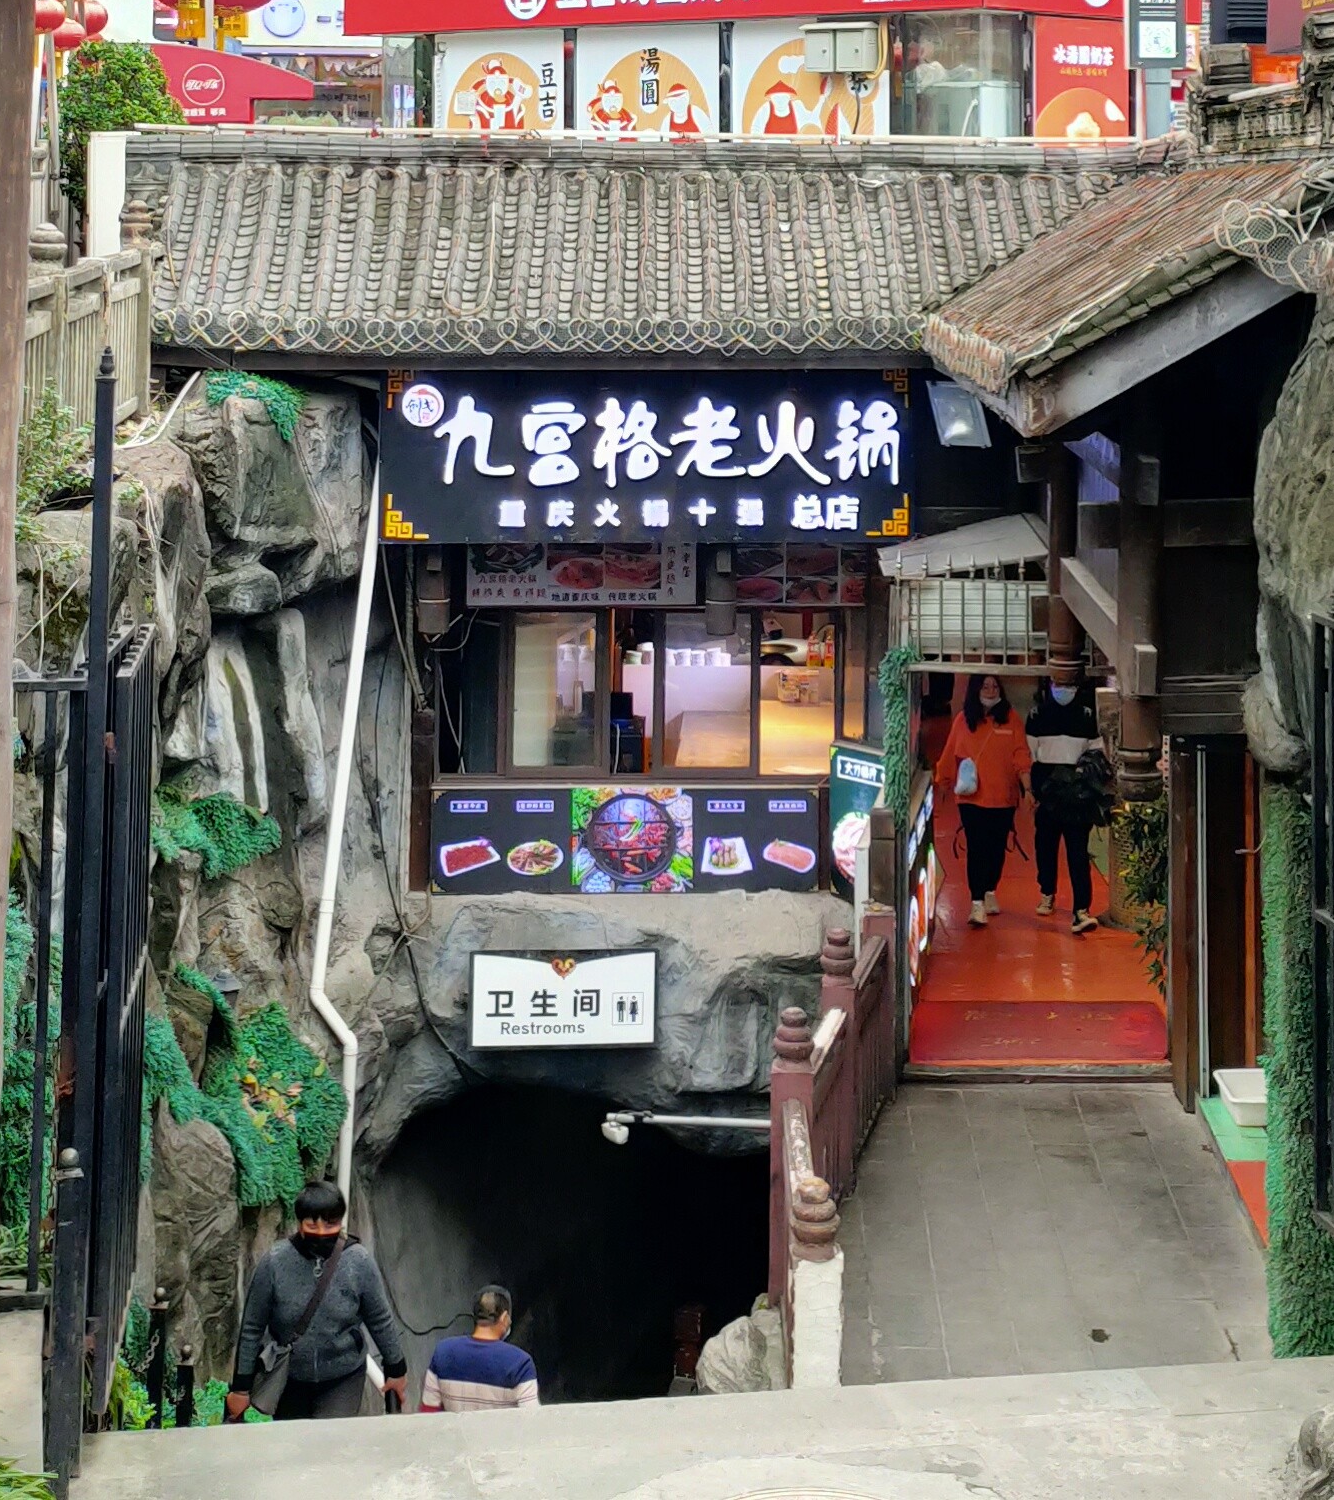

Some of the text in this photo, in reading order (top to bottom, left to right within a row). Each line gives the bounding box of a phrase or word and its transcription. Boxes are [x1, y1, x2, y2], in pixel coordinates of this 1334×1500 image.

[538, 62, 558, 119] 豆吉
[434, 395, 900, 488] 九宫格老火锅
[498, 494, 860, 531] 重庆火锅十强 总店
[486, 989, 601, 1018] 卫生间
[500, 1022, 585, 1035] Restrooms
